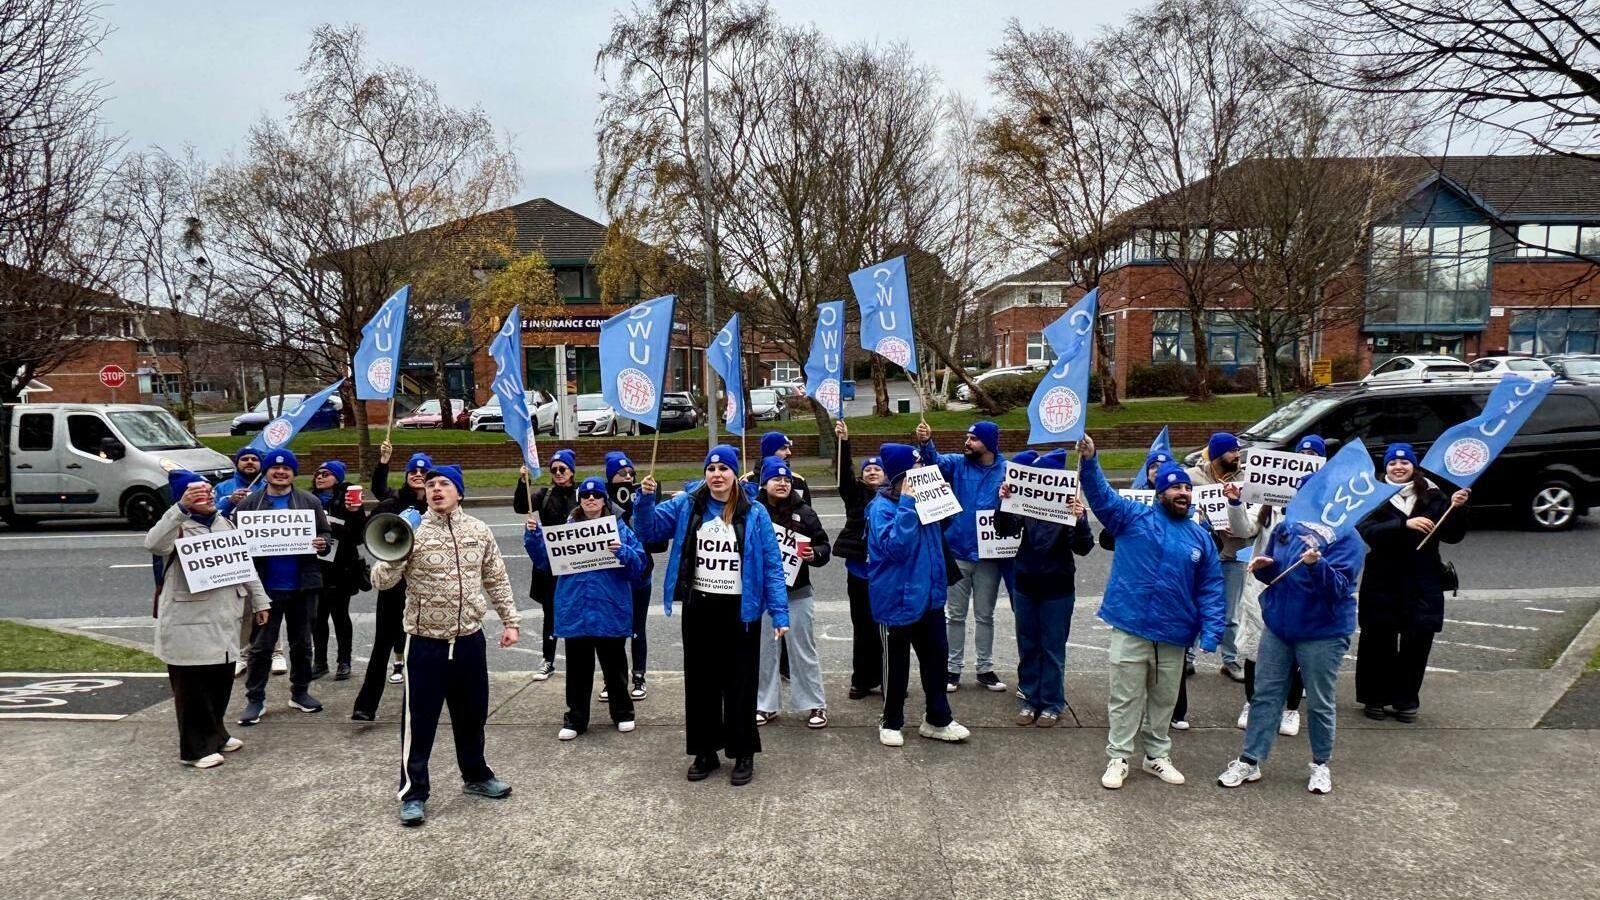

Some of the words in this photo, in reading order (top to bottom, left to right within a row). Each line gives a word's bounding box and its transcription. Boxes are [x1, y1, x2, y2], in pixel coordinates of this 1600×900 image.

[529, 319, 583, 329] INSURANCE
[585, 318, 608, 329] CEN
[101, 371, 124, 381] STOP
[1008, 468, 1077, 489] OFFICIAL
[1249, 472, 1301, 491] DISPU
[1009, 483, 1076, 506] DISPUTE
[241, 514, 313, 525] OFFICIAL
[244, 527, 312, 539] DISPUTE
[545, 523, 616, 543] OFFICIAL
[180, 535, 246, 556] OFFICIAL
[551, 538, 616, 557] DISPUTE
[698, 538, 740, 553] ICIAL
[187, 551, 249, 572] DISPUTE
[696, 556, 740, 572] PUTE
[712, 583, 734, 591] UNION
